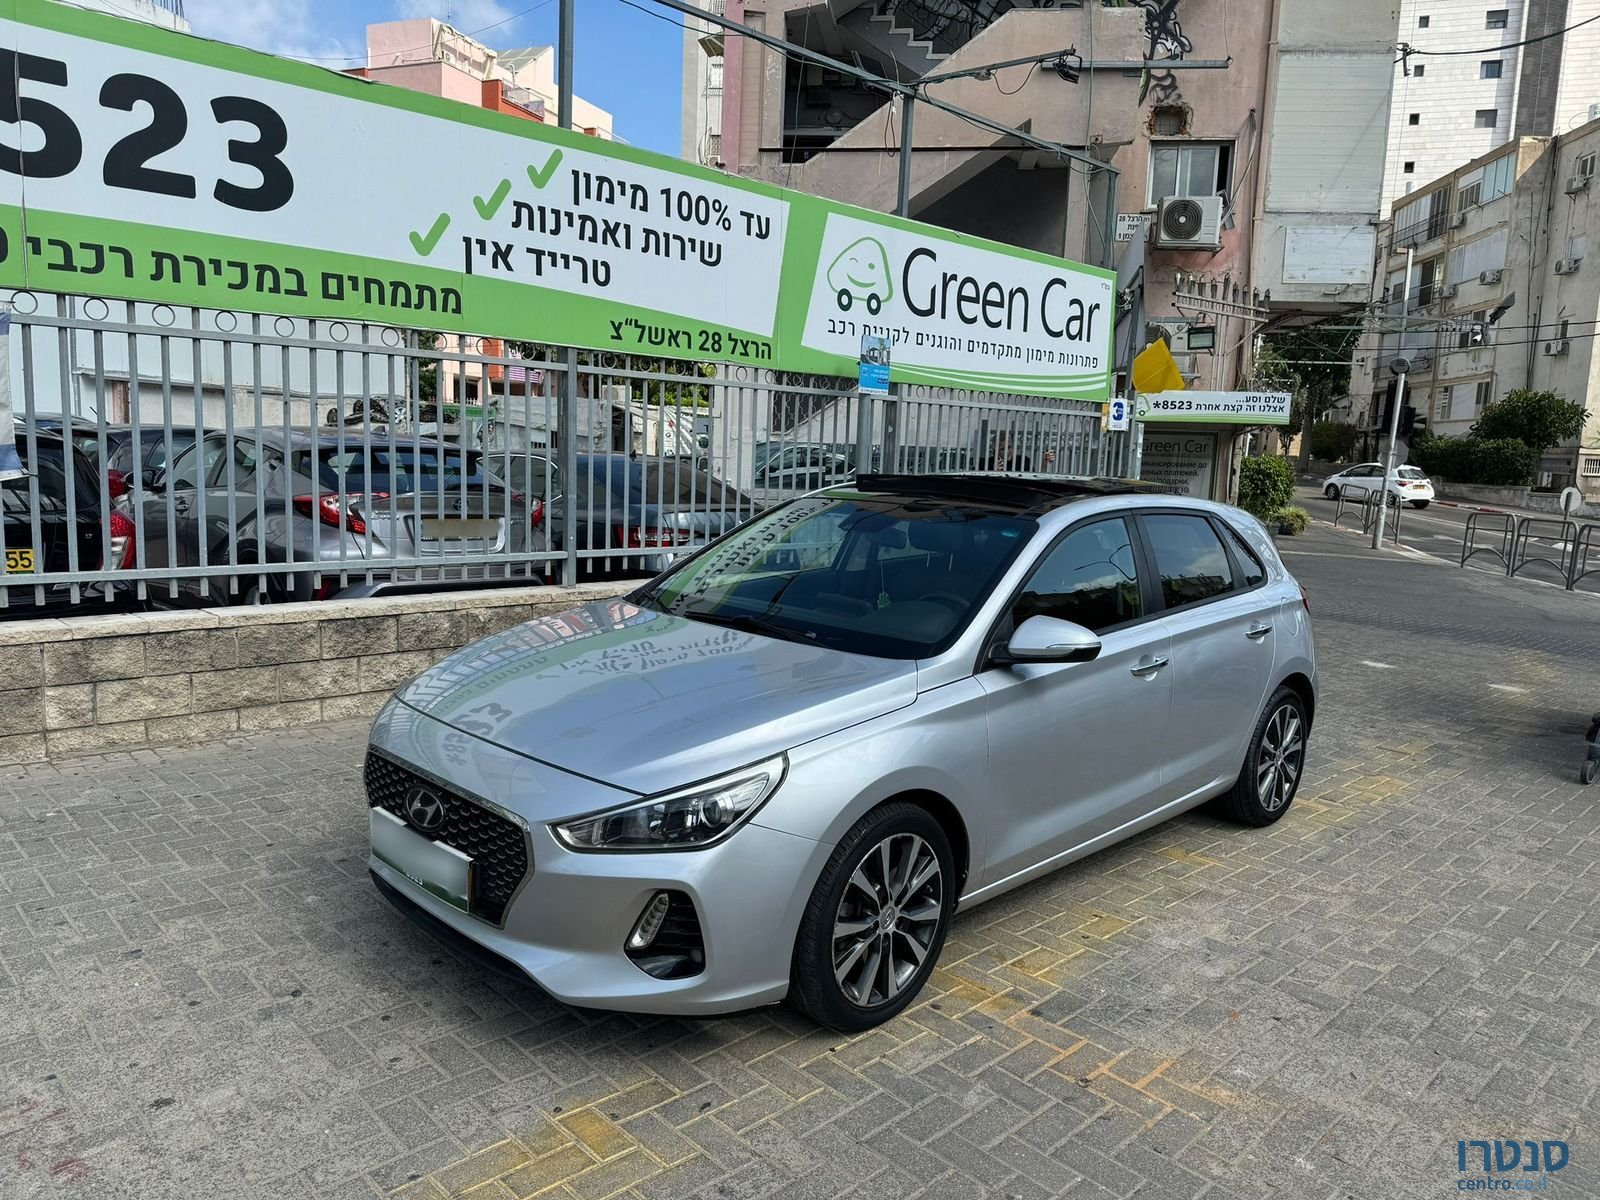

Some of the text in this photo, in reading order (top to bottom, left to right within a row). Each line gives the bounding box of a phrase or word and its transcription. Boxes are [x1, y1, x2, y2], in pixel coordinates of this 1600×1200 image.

[572, 169, 769, 239] עד 100% מימון
[511, 201, 721, 266] שירות ואמינות
[26, 236, 133, 278] רכבי
[462, 236, 610, 286] טרייד אין
[150, 251, 307, 296] במכירת
[322, 272, 461, 314] מתמחים
[903, 248, 1100, 343] Green Car
[828, 318, 855, 337] רכב
[699, 329, 723, 353] 28
[728, 333, 772, 359] הרצל
[916, 332, 961, 351] והוגנים
[968, 339, 1022, 360] מתקדמים
[1027, 348, 1054, 364] מימון
[1059, 353, 1098, 368] פתרונות
[1195, 403, 1220, 411] אחרת
[1223, 404, 1243, 413] קצת
[1259, 404, 1285, 413] אצלנו
[1265, 395, 1285, 404] שלם
[1185, 439, 1209, 453] Car
